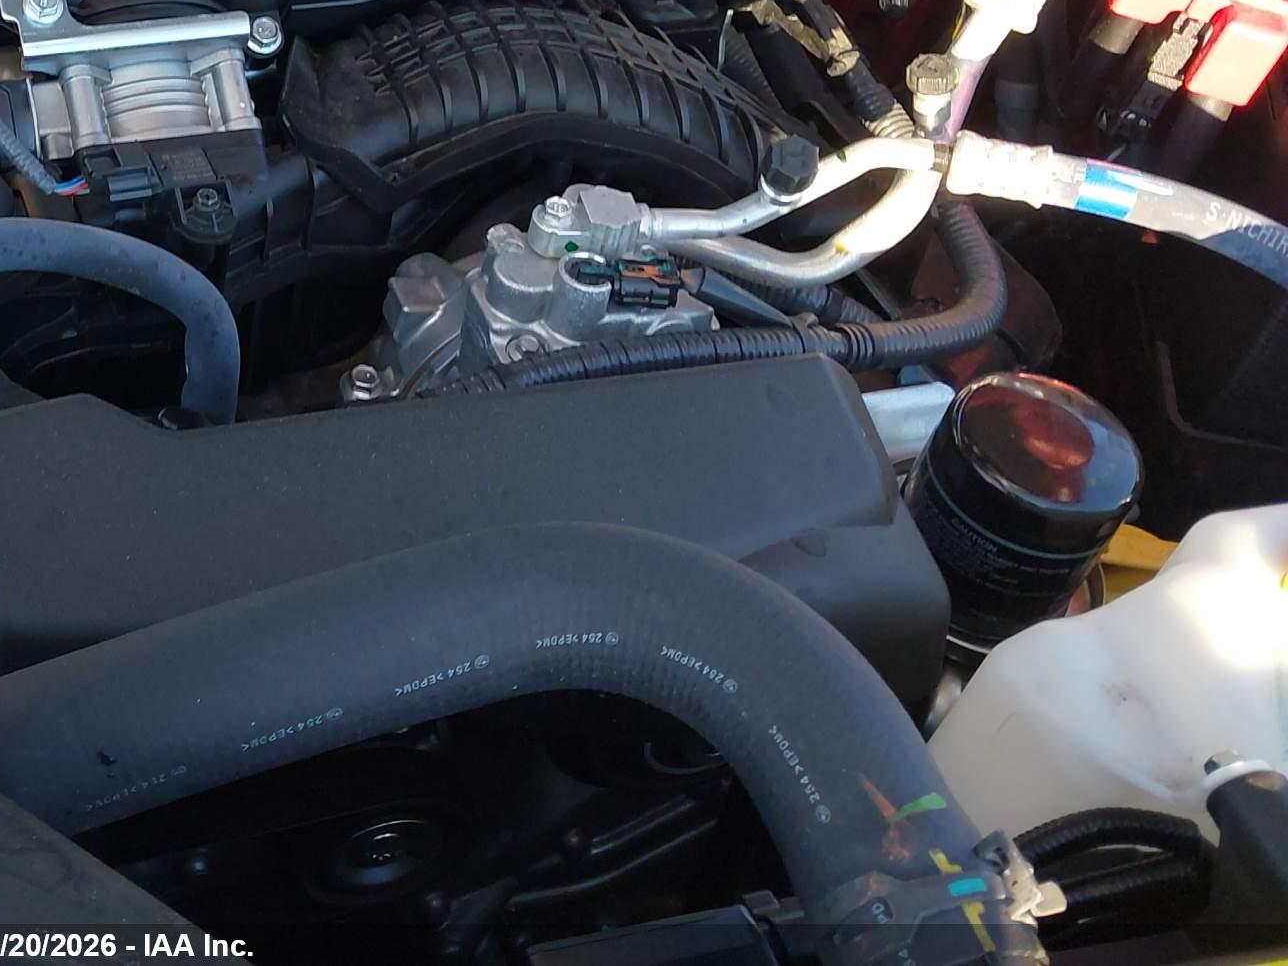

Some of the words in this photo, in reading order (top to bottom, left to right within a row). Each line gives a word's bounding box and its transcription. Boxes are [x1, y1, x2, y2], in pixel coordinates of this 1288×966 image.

[581, 631, 603, 645] 254
[447, 661, 472, 678] 254
[703, 664, 724, 685] 254
